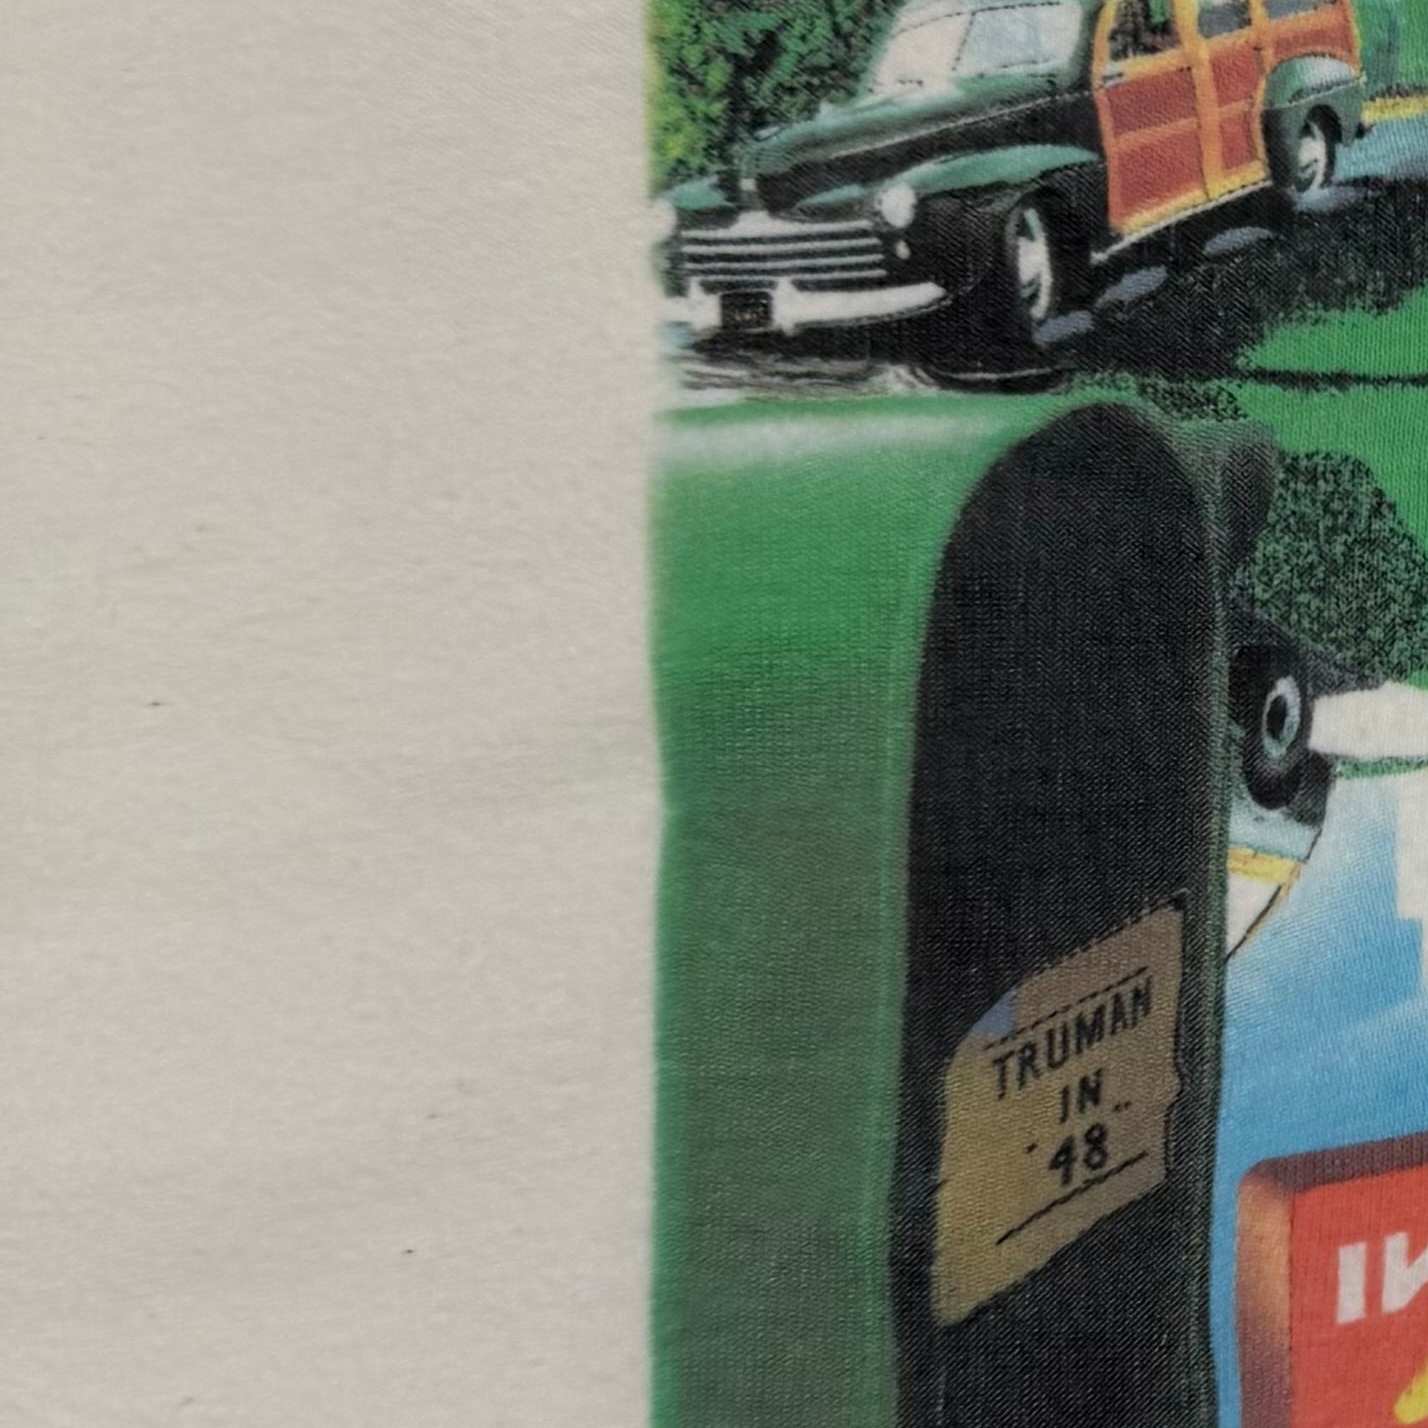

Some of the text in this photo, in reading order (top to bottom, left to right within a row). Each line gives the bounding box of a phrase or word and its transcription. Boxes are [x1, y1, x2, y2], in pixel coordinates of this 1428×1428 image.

[991, 975, 1154, 1102] TRUMAN
[1059, 1069, 1104, 1124] IN
[1047, 1122, 1109, 1186] 48
